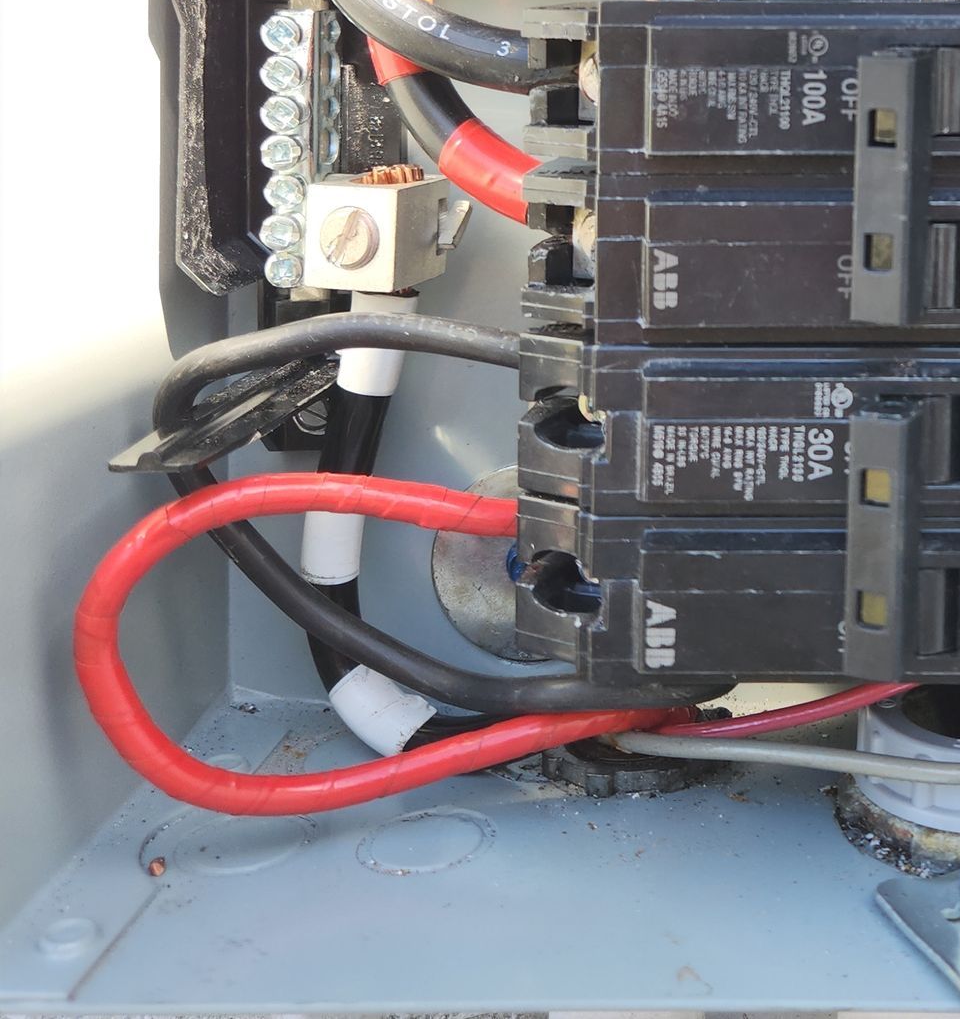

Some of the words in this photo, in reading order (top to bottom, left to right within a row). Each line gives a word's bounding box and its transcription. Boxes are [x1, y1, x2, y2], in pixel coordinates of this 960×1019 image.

[801, 69, 826, 127] 100A
[841, 77, 859, 122] OFF
[652, 248, 679, 311] ABB
[807, 426, 835, 481] 30A
[644, 599, 677, 669] ABB
